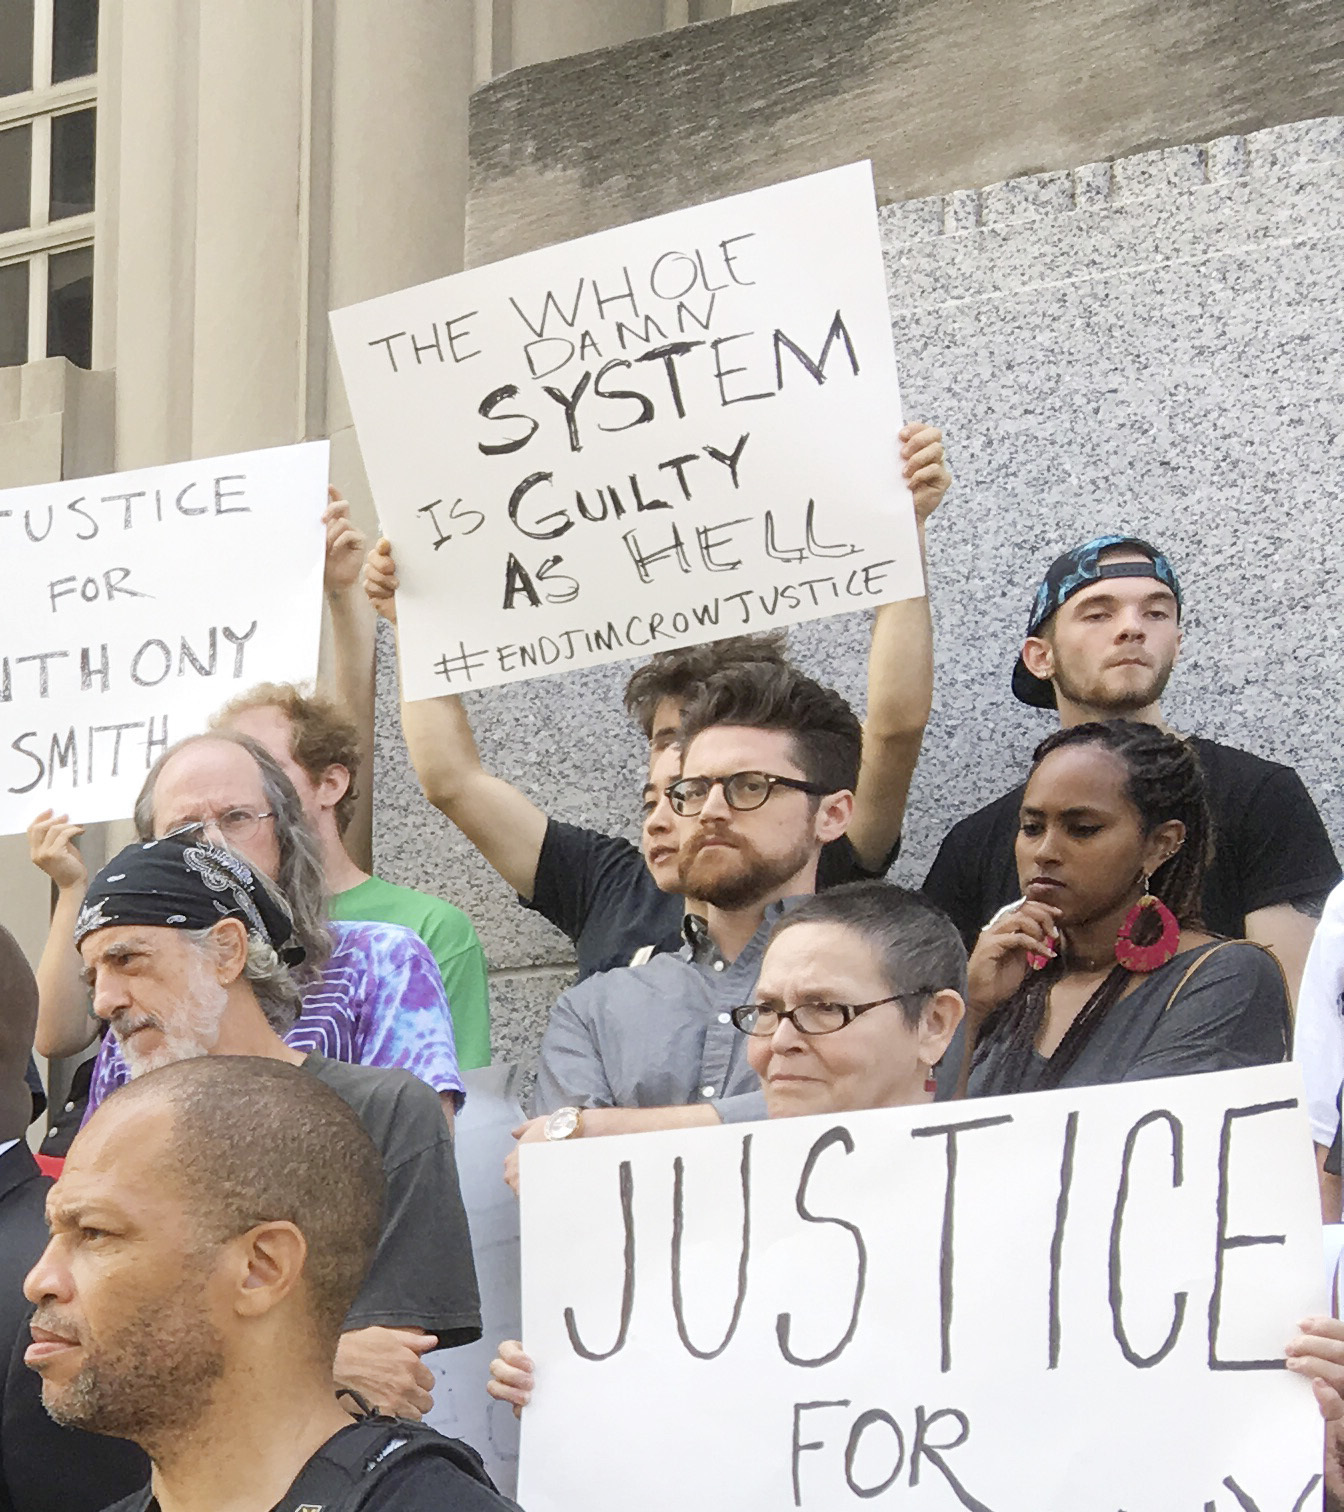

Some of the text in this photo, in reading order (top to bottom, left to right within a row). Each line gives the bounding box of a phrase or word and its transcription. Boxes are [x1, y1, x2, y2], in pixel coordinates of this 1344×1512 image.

[369, 233, 758, 371] THE WHOLE
[524, 292, 716, 380] DAMN
[477, 309, 862, 456] SYSTEM
[417, 433, 750, 551] IS GUILTY
[48, 567, 157, 613] FOR
[502, 498, 865, 610] AS HELL
[434, 560, 896, 683] #ENDJIMCROWJUSTICE
[8, 715, 171, 795] SMITH
[563, 1098, 1300, 1374] JUSTICE
